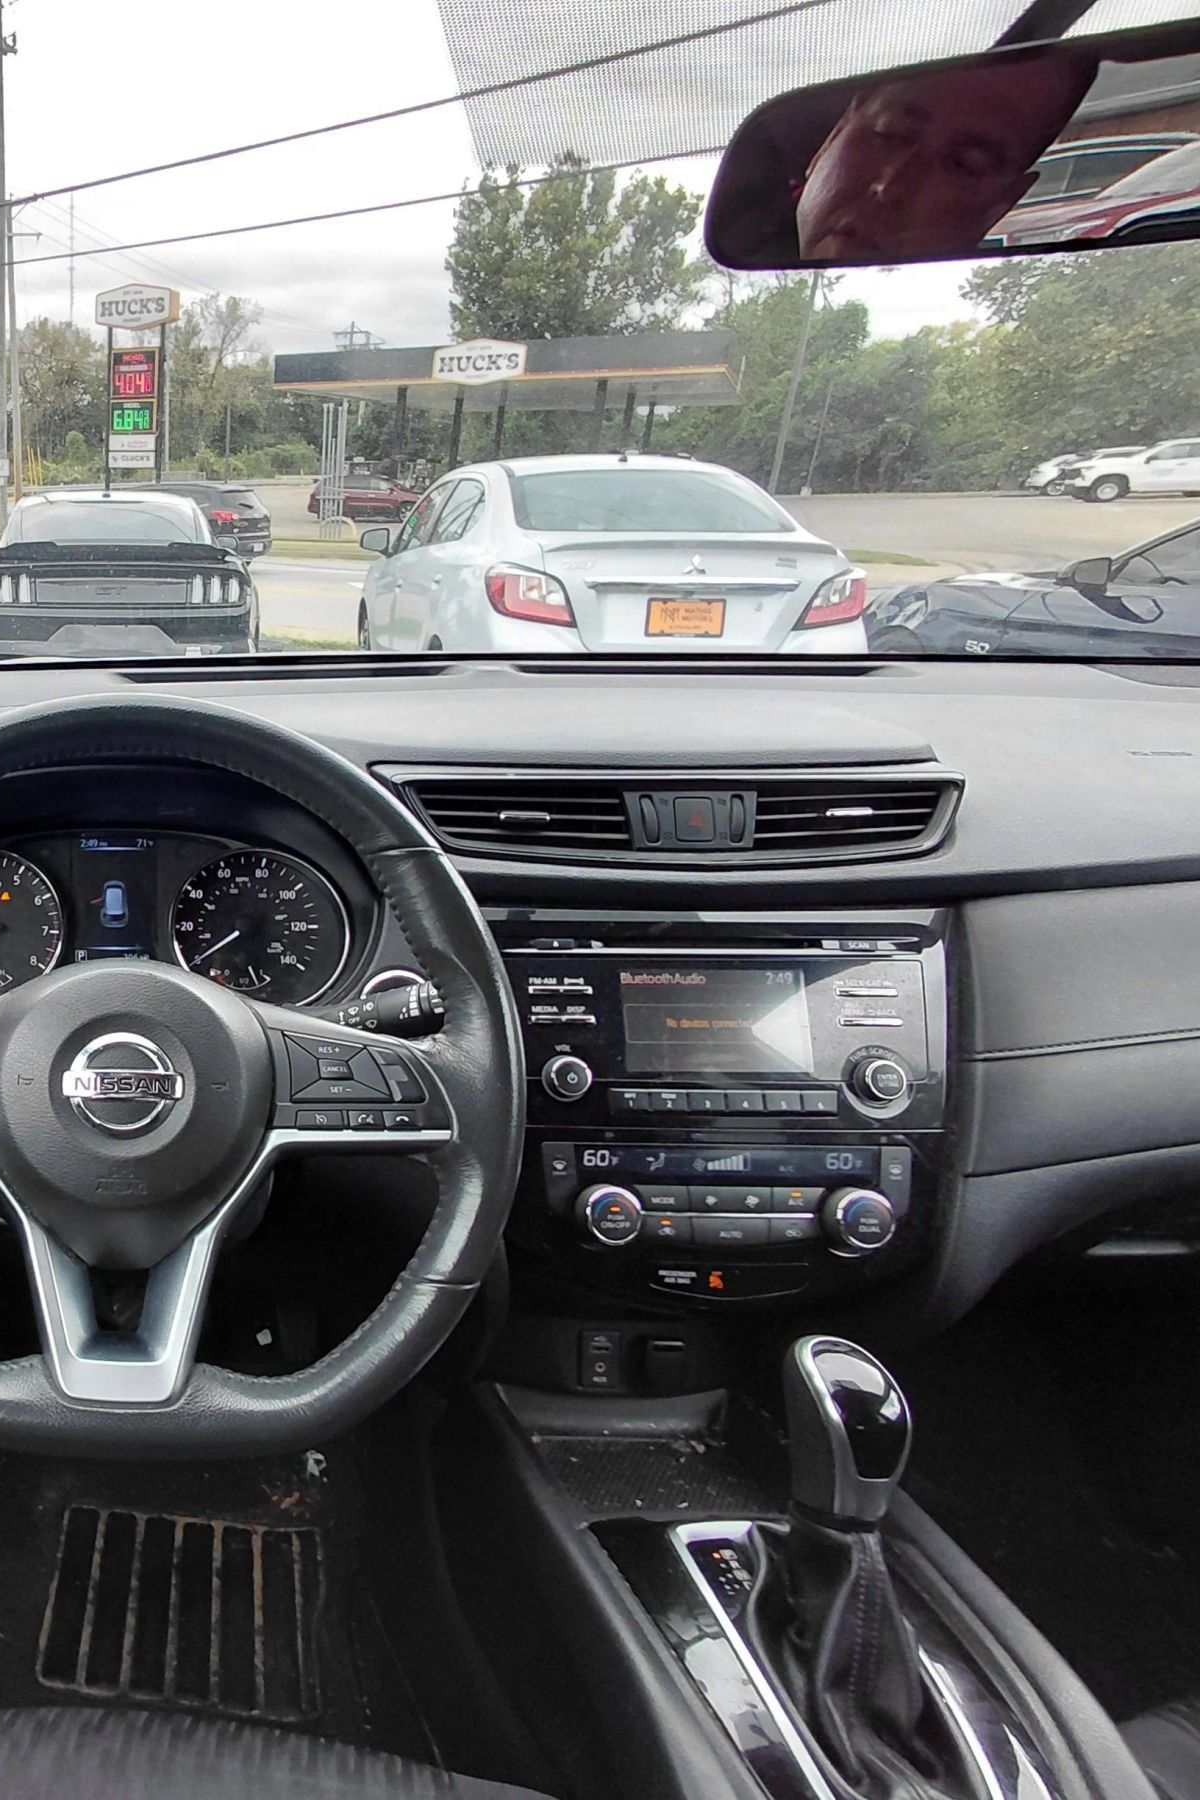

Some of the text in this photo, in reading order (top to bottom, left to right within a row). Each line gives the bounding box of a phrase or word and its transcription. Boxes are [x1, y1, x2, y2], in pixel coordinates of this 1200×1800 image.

[100, 297, 165, 318] HUCK'S
[438, 352, 520, 373] HUCK'S
[80, 839, 99, 848] 2:49
[217, 868, 231, 879] 60
[255, 868, 269, 879] 80
[13, 874, 22, 887] 5
[189, 889, 203, 899] 40
[279, 890, 296, 900] 100
[33, 894, 43, 907] 6
[41, 925, 50, 937] 7
[181, 921, 194, 931] 20
[290, 921, 307, 932] 120
[848, 941, 870, 949] SCAN
[280, 954, 297, 965] 140
[765, 971, 793, 985] 2:49
[531, 1005, 559, 1013] MEDIA
[318, 1046, 333, 1054] RES
[322, 1065, 349, 1073] CANCEL
[74, 1076, 172, 1095] NISSAN
[330, 1086, 344, 1094] SET
[651, 1196, 675, 1205] MODE
[719, 1230, 742, 1238] AUTO
[858, 1225, 881, 1233] DUAL
